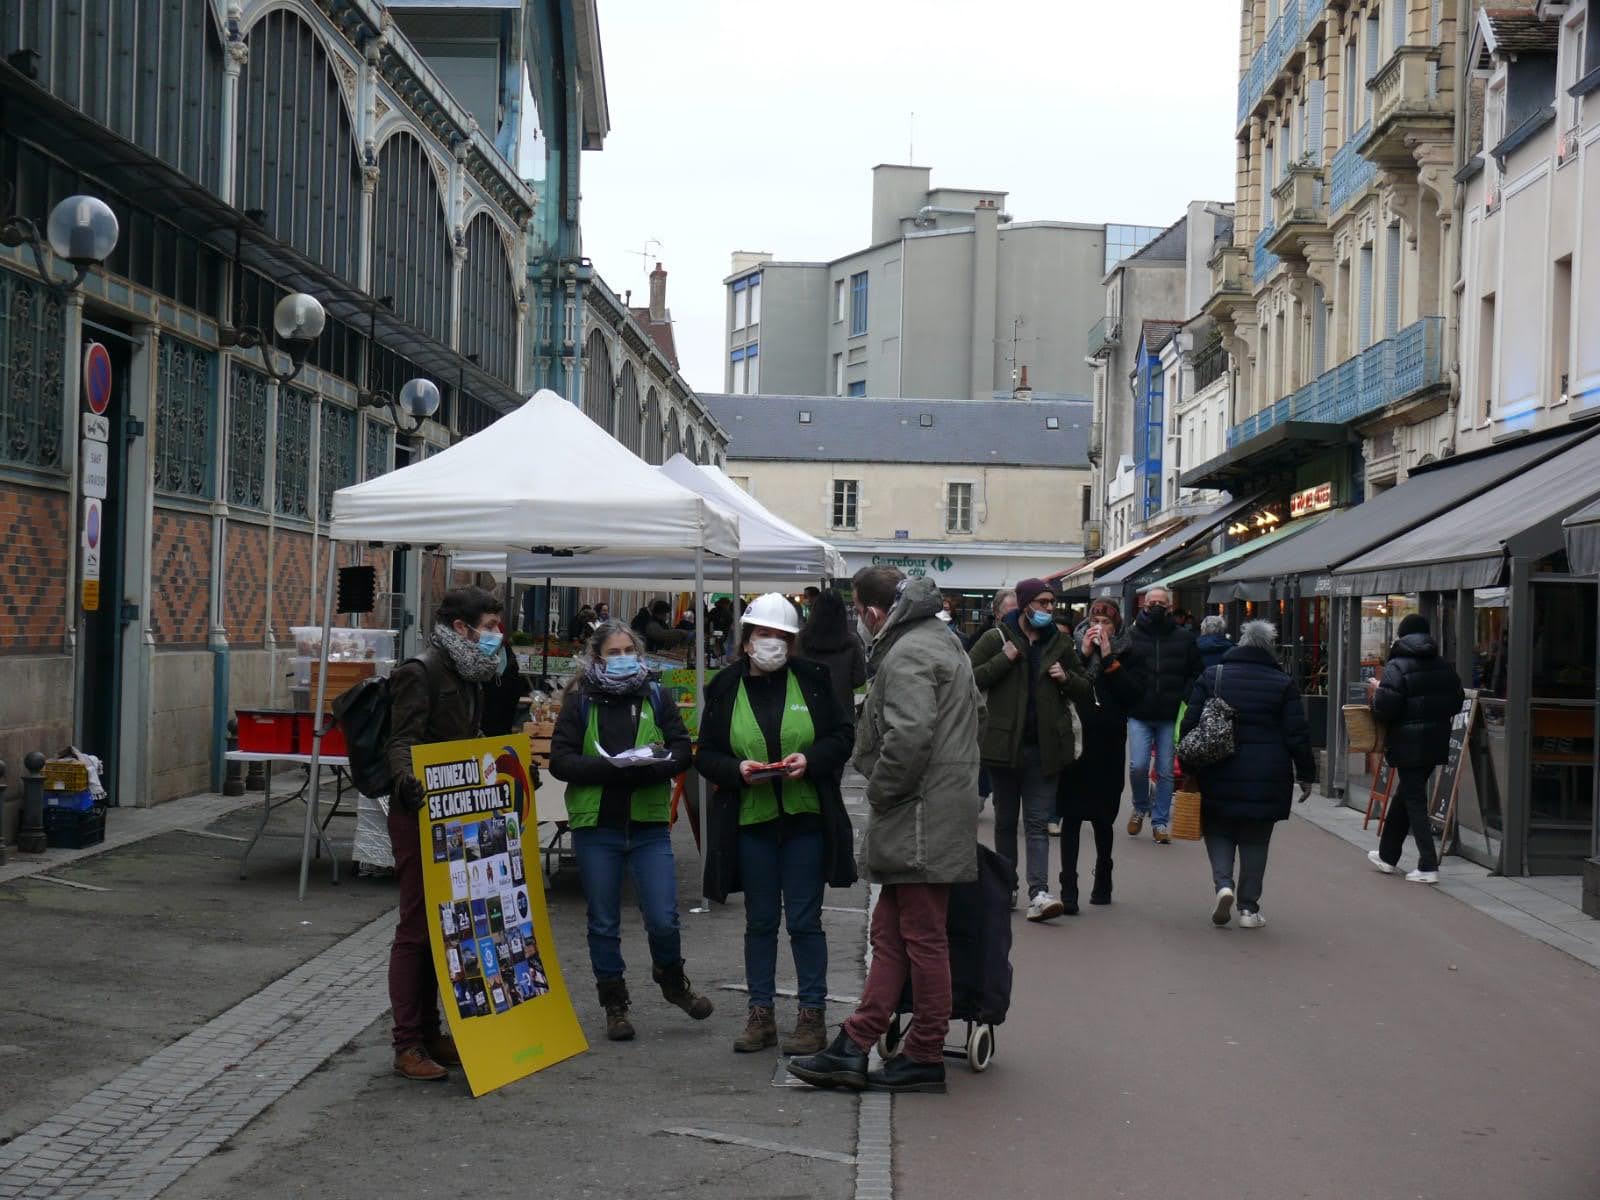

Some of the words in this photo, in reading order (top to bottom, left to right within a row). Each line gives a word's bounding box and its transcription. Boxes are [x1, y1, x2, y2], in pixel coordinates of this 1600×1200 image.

[872, 555, 927, 567] Carrefour
[908, 567, 926, 577] city
[425, 762, 465, 790] DEVINEZ
[429, 795, 442, 819] SE
[442, 790, 473, 816] CACHE
[473, 786, 504, 812] TOTAL
